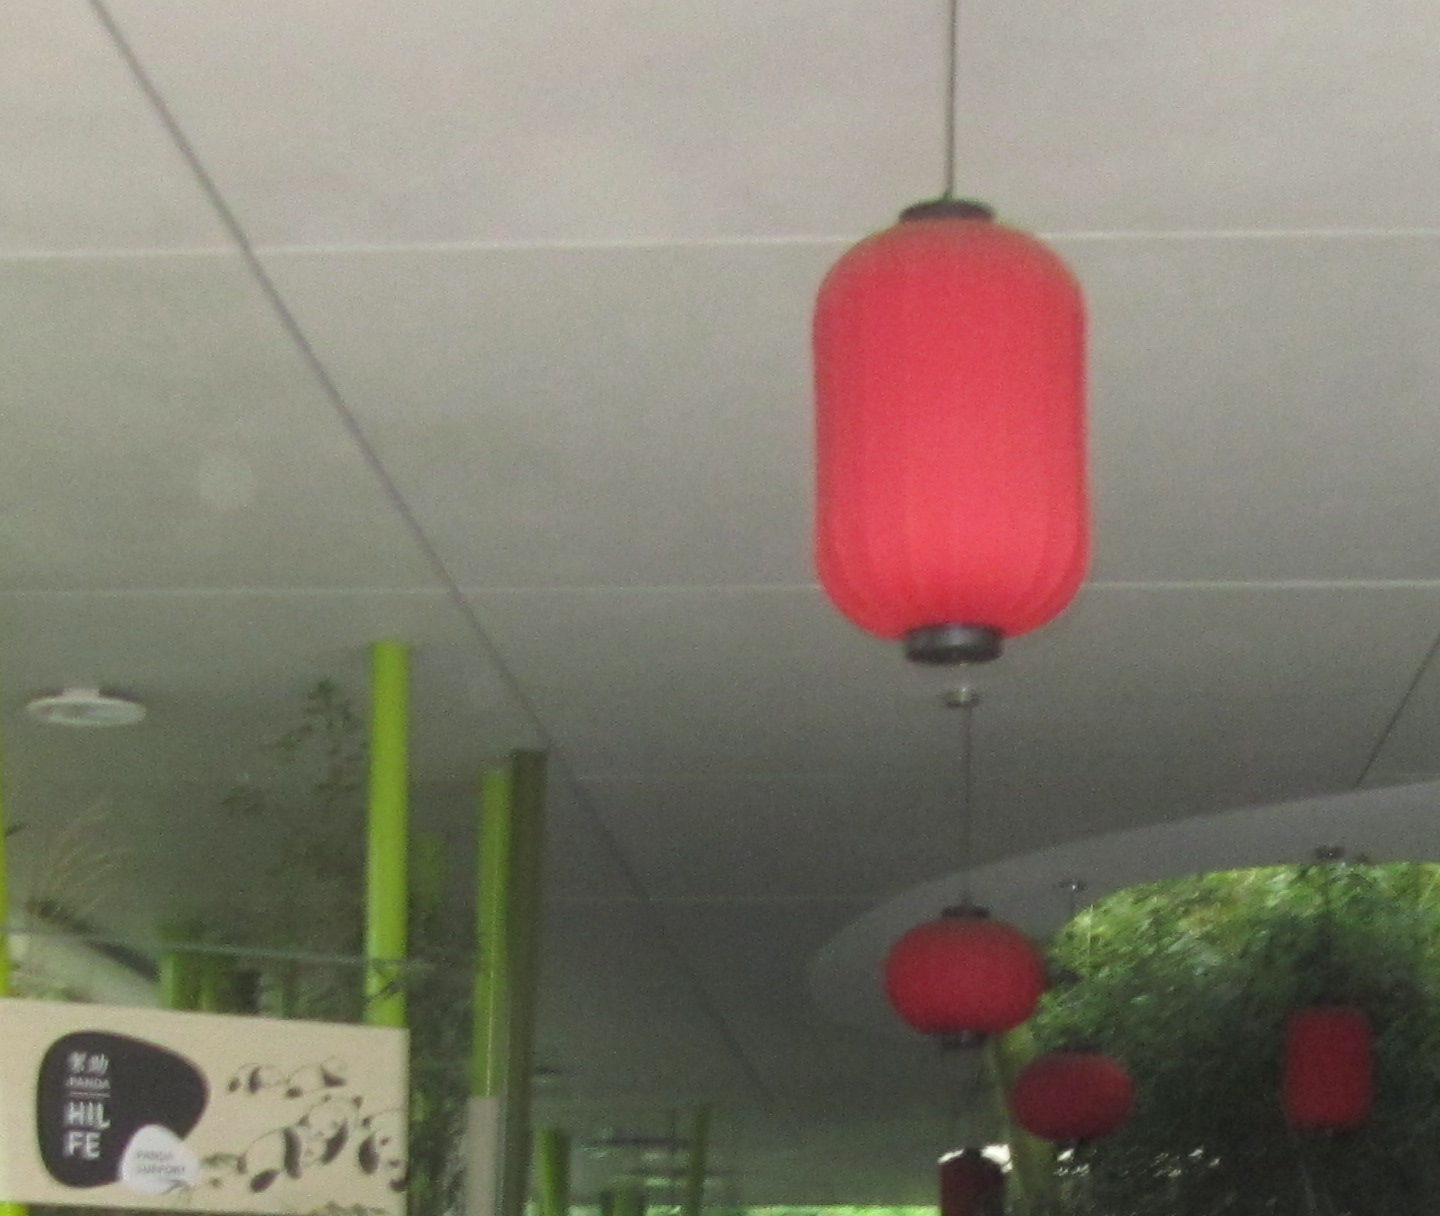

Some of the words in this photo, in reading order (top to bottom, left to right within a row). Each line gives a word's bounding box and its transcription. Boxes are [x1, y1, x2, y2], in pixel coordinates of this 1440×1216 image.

[66, 1076, 111, 1090] PANDA
[66, 1101, 111, 1130] HIL
[66, 1131, 101, 1158] FE
